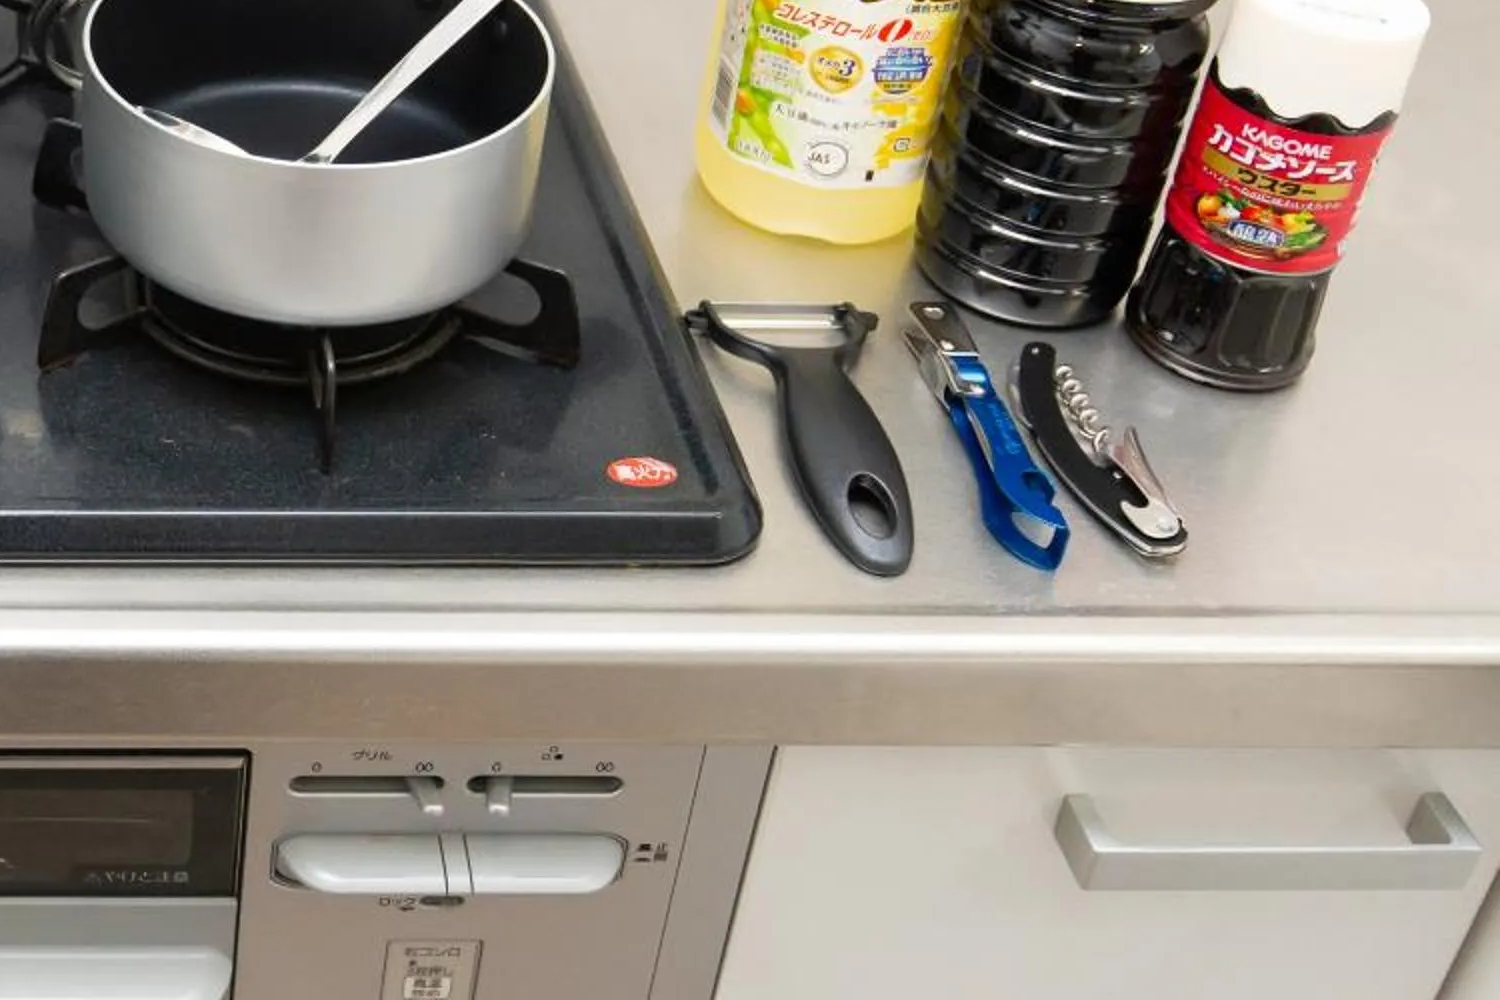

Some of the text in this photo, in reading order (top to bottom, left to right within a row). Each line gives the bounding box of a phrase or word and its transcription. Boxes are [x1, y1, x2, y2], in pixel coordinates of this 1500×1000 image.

[1206, 123, 1357, 183] カゴメソース
[1241, 123, 1333, 160] KAGOME
[1237, 167, 1317, 197] ウスター
